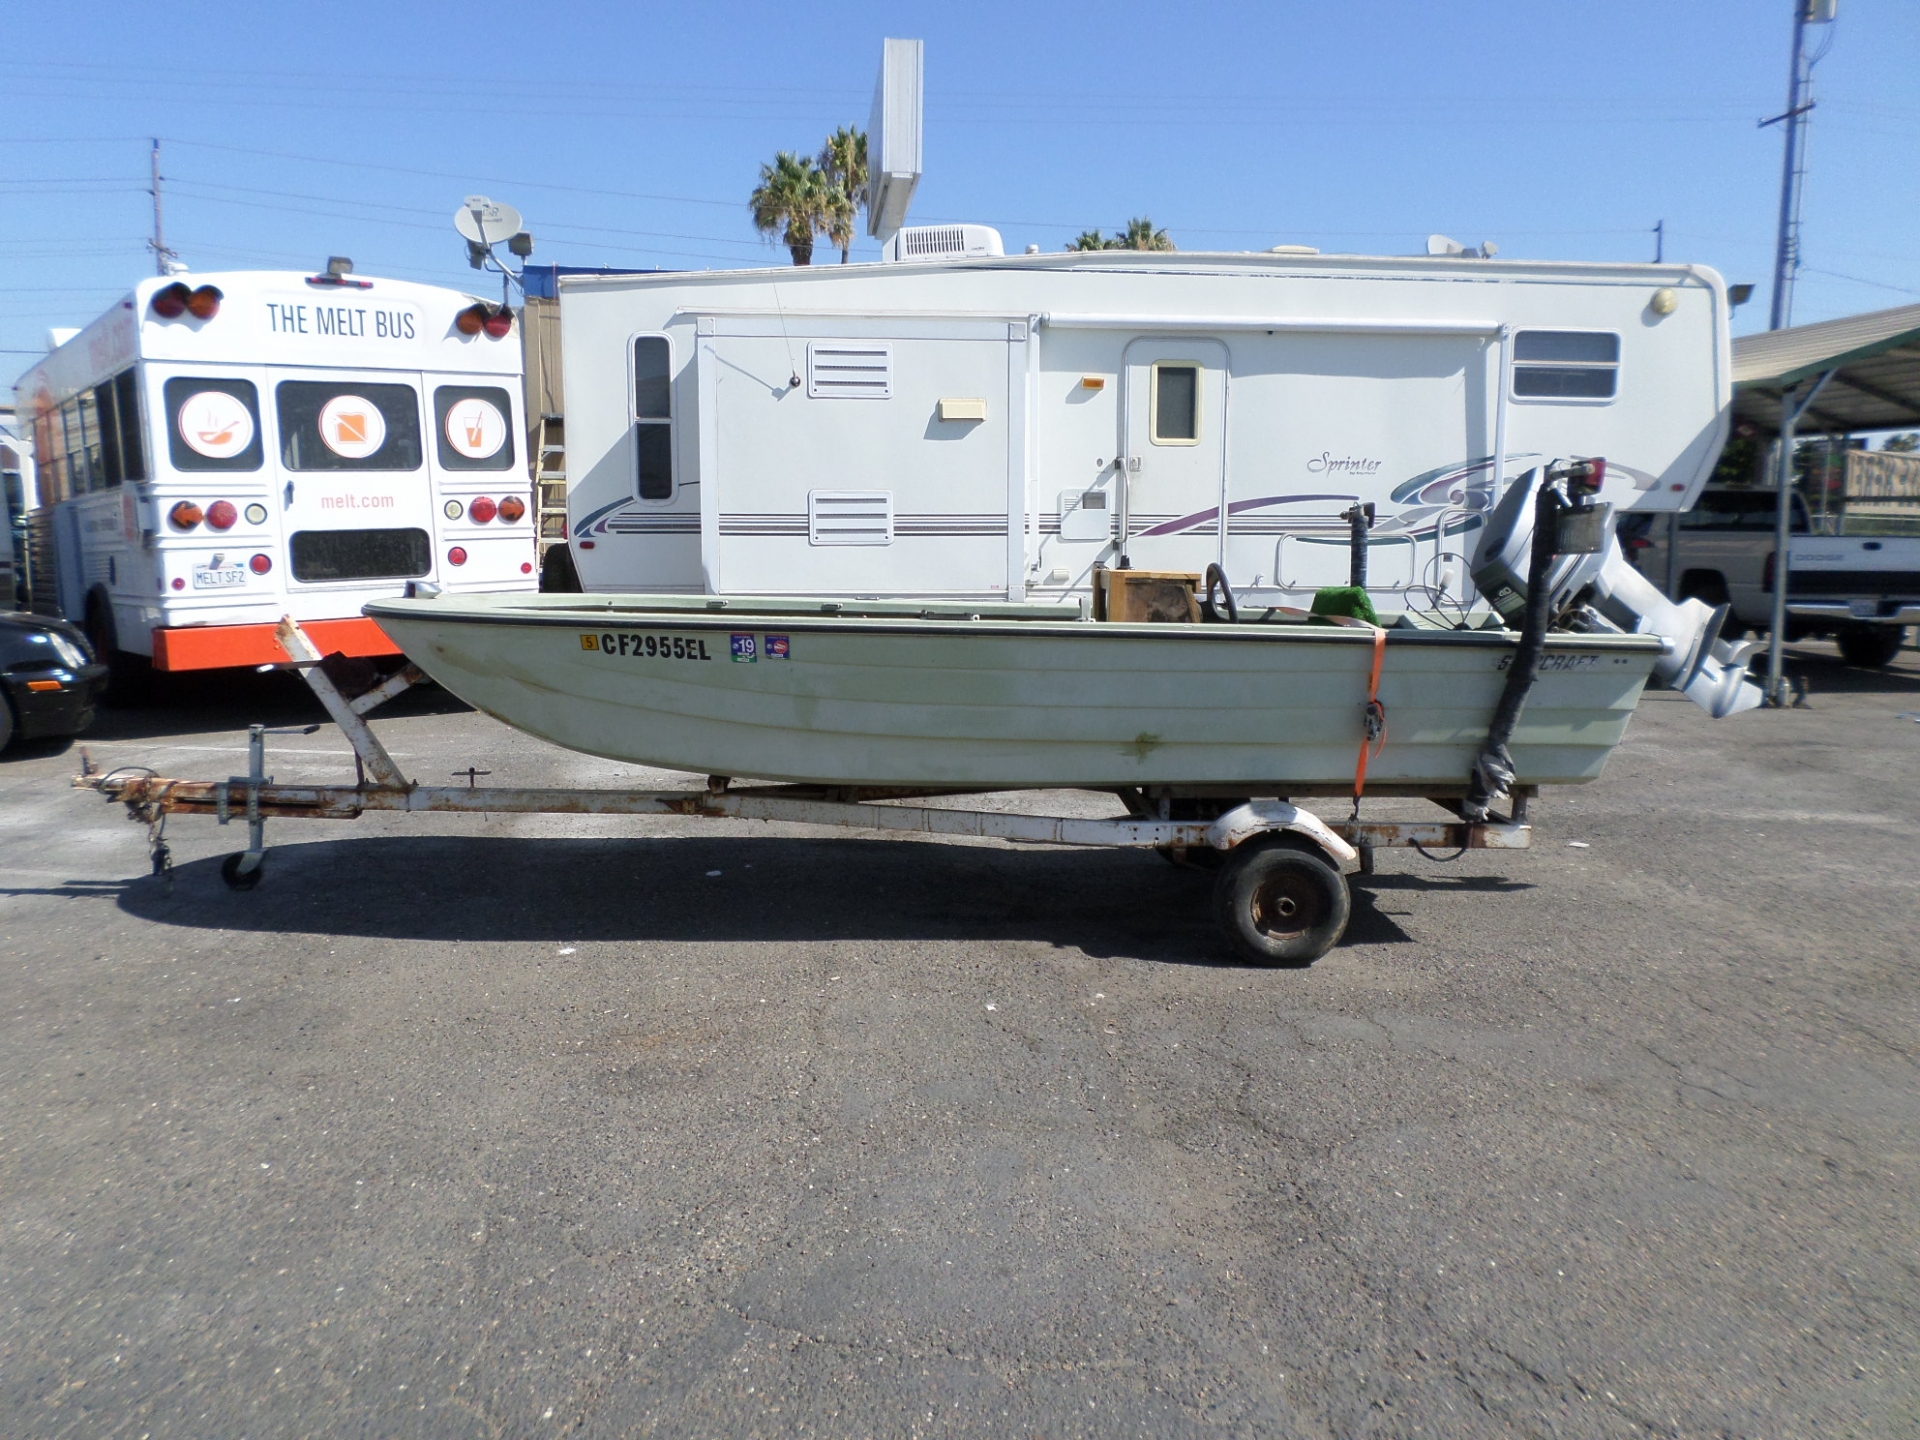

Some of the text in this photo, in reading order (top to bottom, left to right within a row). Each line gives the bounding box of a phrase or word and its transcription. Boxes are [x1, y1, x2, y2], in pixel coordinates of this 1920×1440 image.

[266, 303, 415, 340] THE MELT BUS
[1306, 451, 1382, 478] Sprinter
[321, 493, 394, 509] melt.com
[586, 637, 594, 648] 5
[601, 633, 712, 660] CF2955EL
[738, 638, 755, 653] 19
